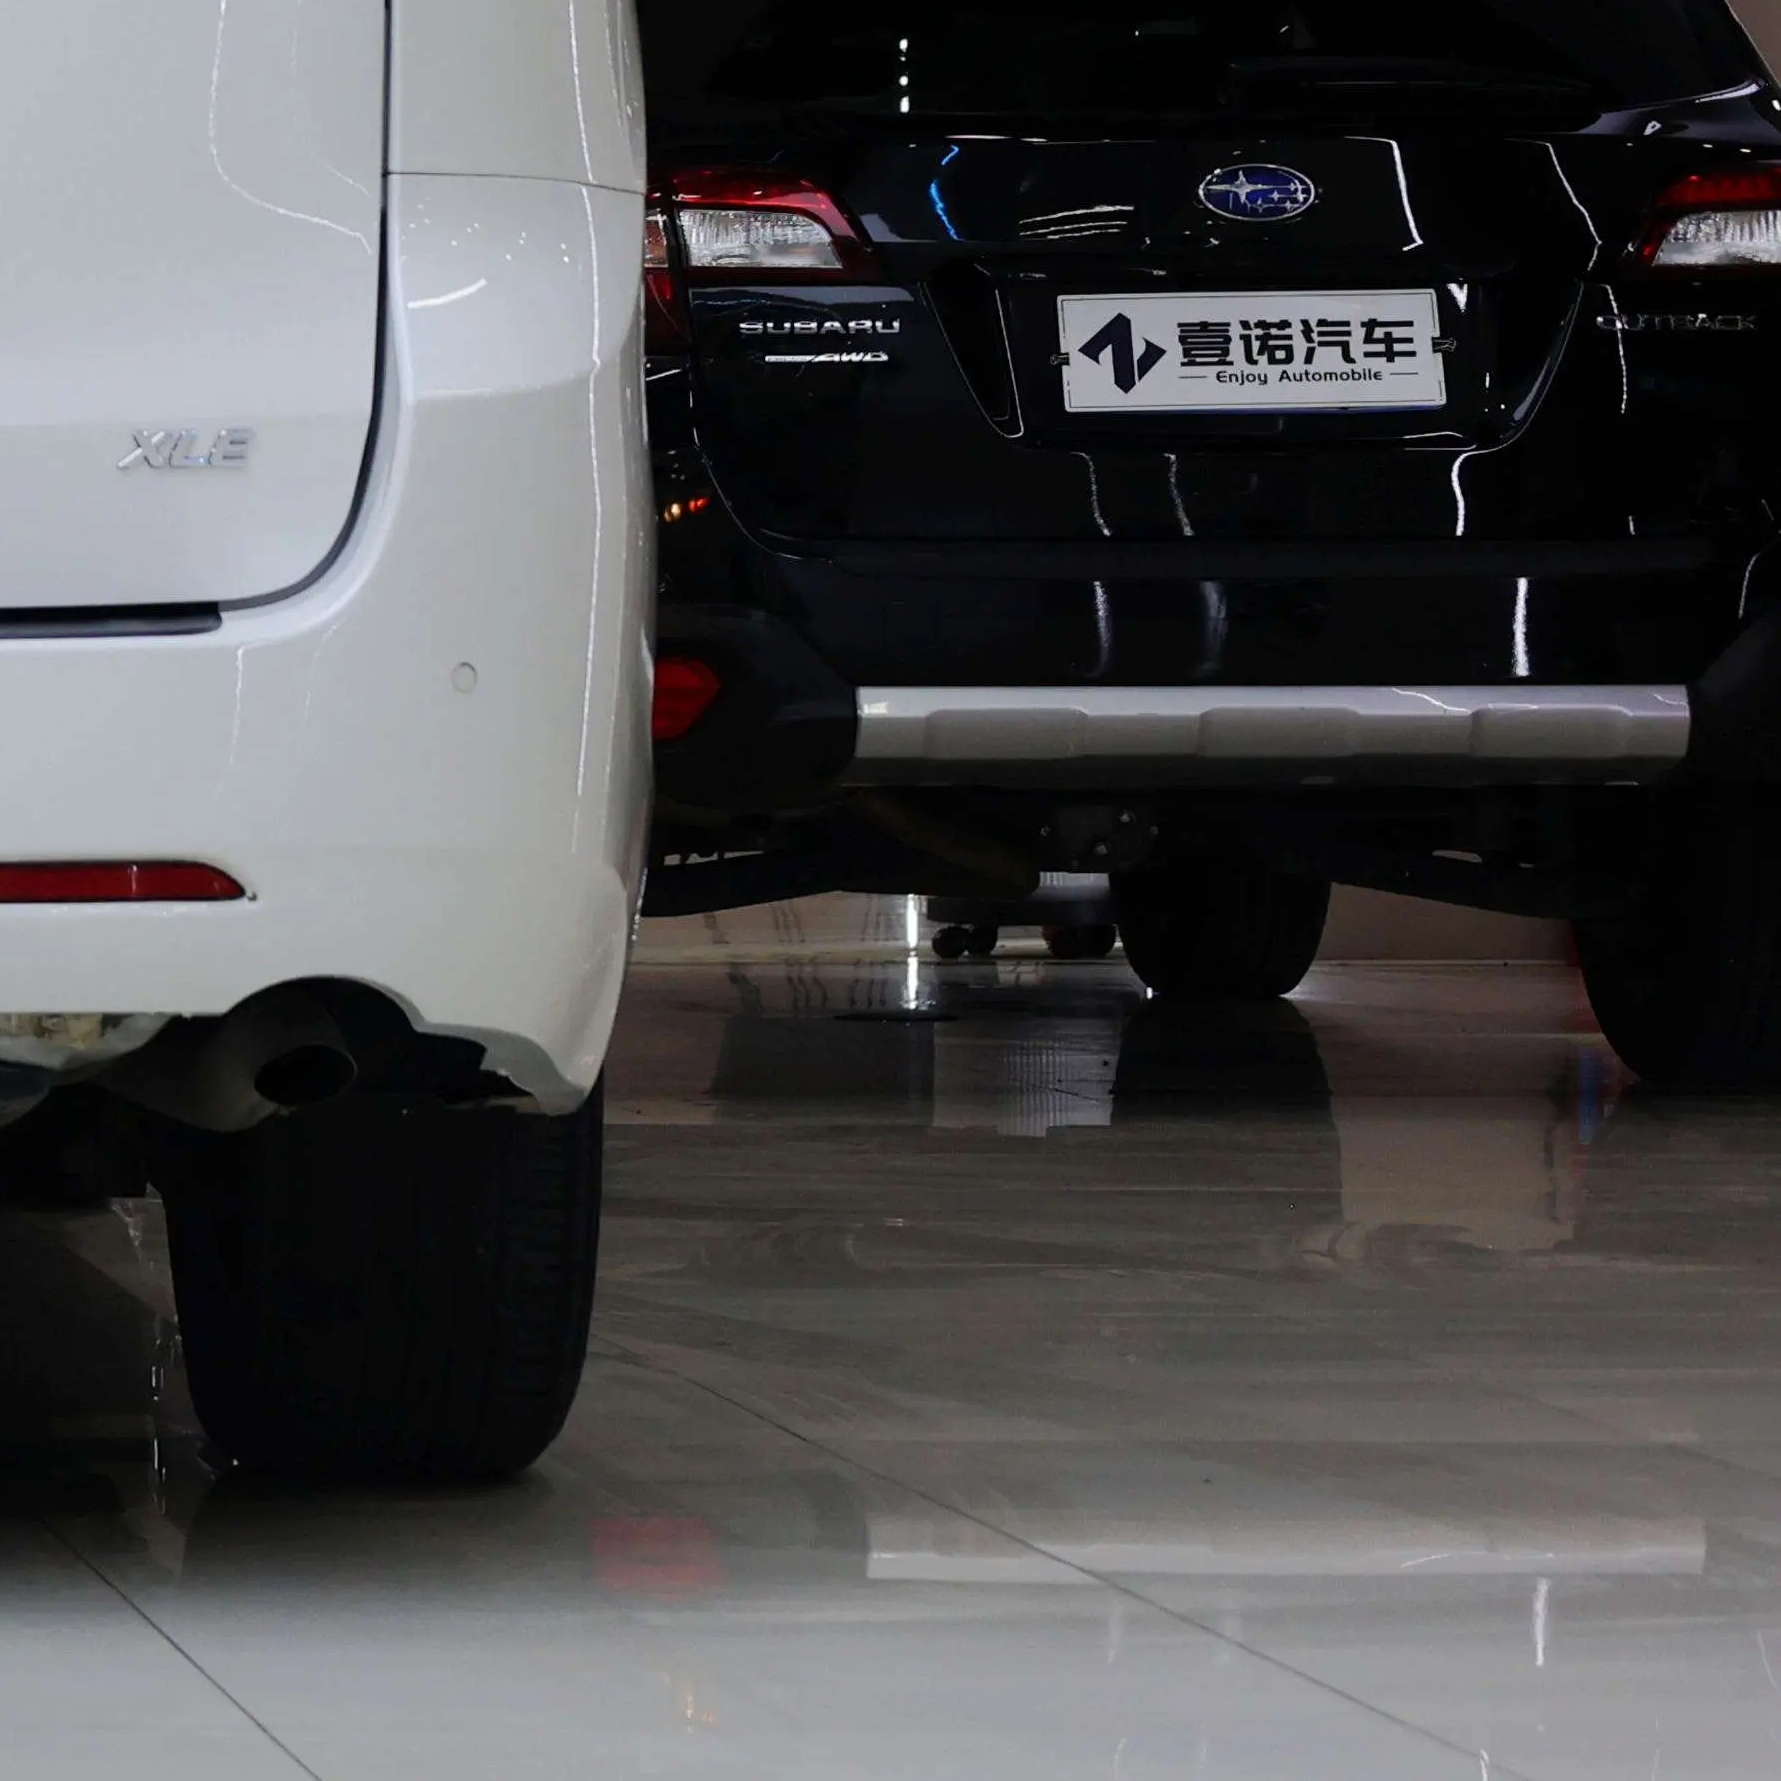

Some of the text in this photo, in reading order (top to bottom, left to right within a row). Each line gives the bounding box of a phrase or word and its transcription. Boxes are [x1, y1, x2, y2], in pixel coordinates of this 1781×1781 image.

[738, 319, 901, 335] SUBARU
[1177, 318, 1417, 367] 壹诺汽车
[812, 350, 890, 363] AWD
[1215, 368, 1383, 386] Enjoy Automobile
[116, 427, 257, 469] XLE
